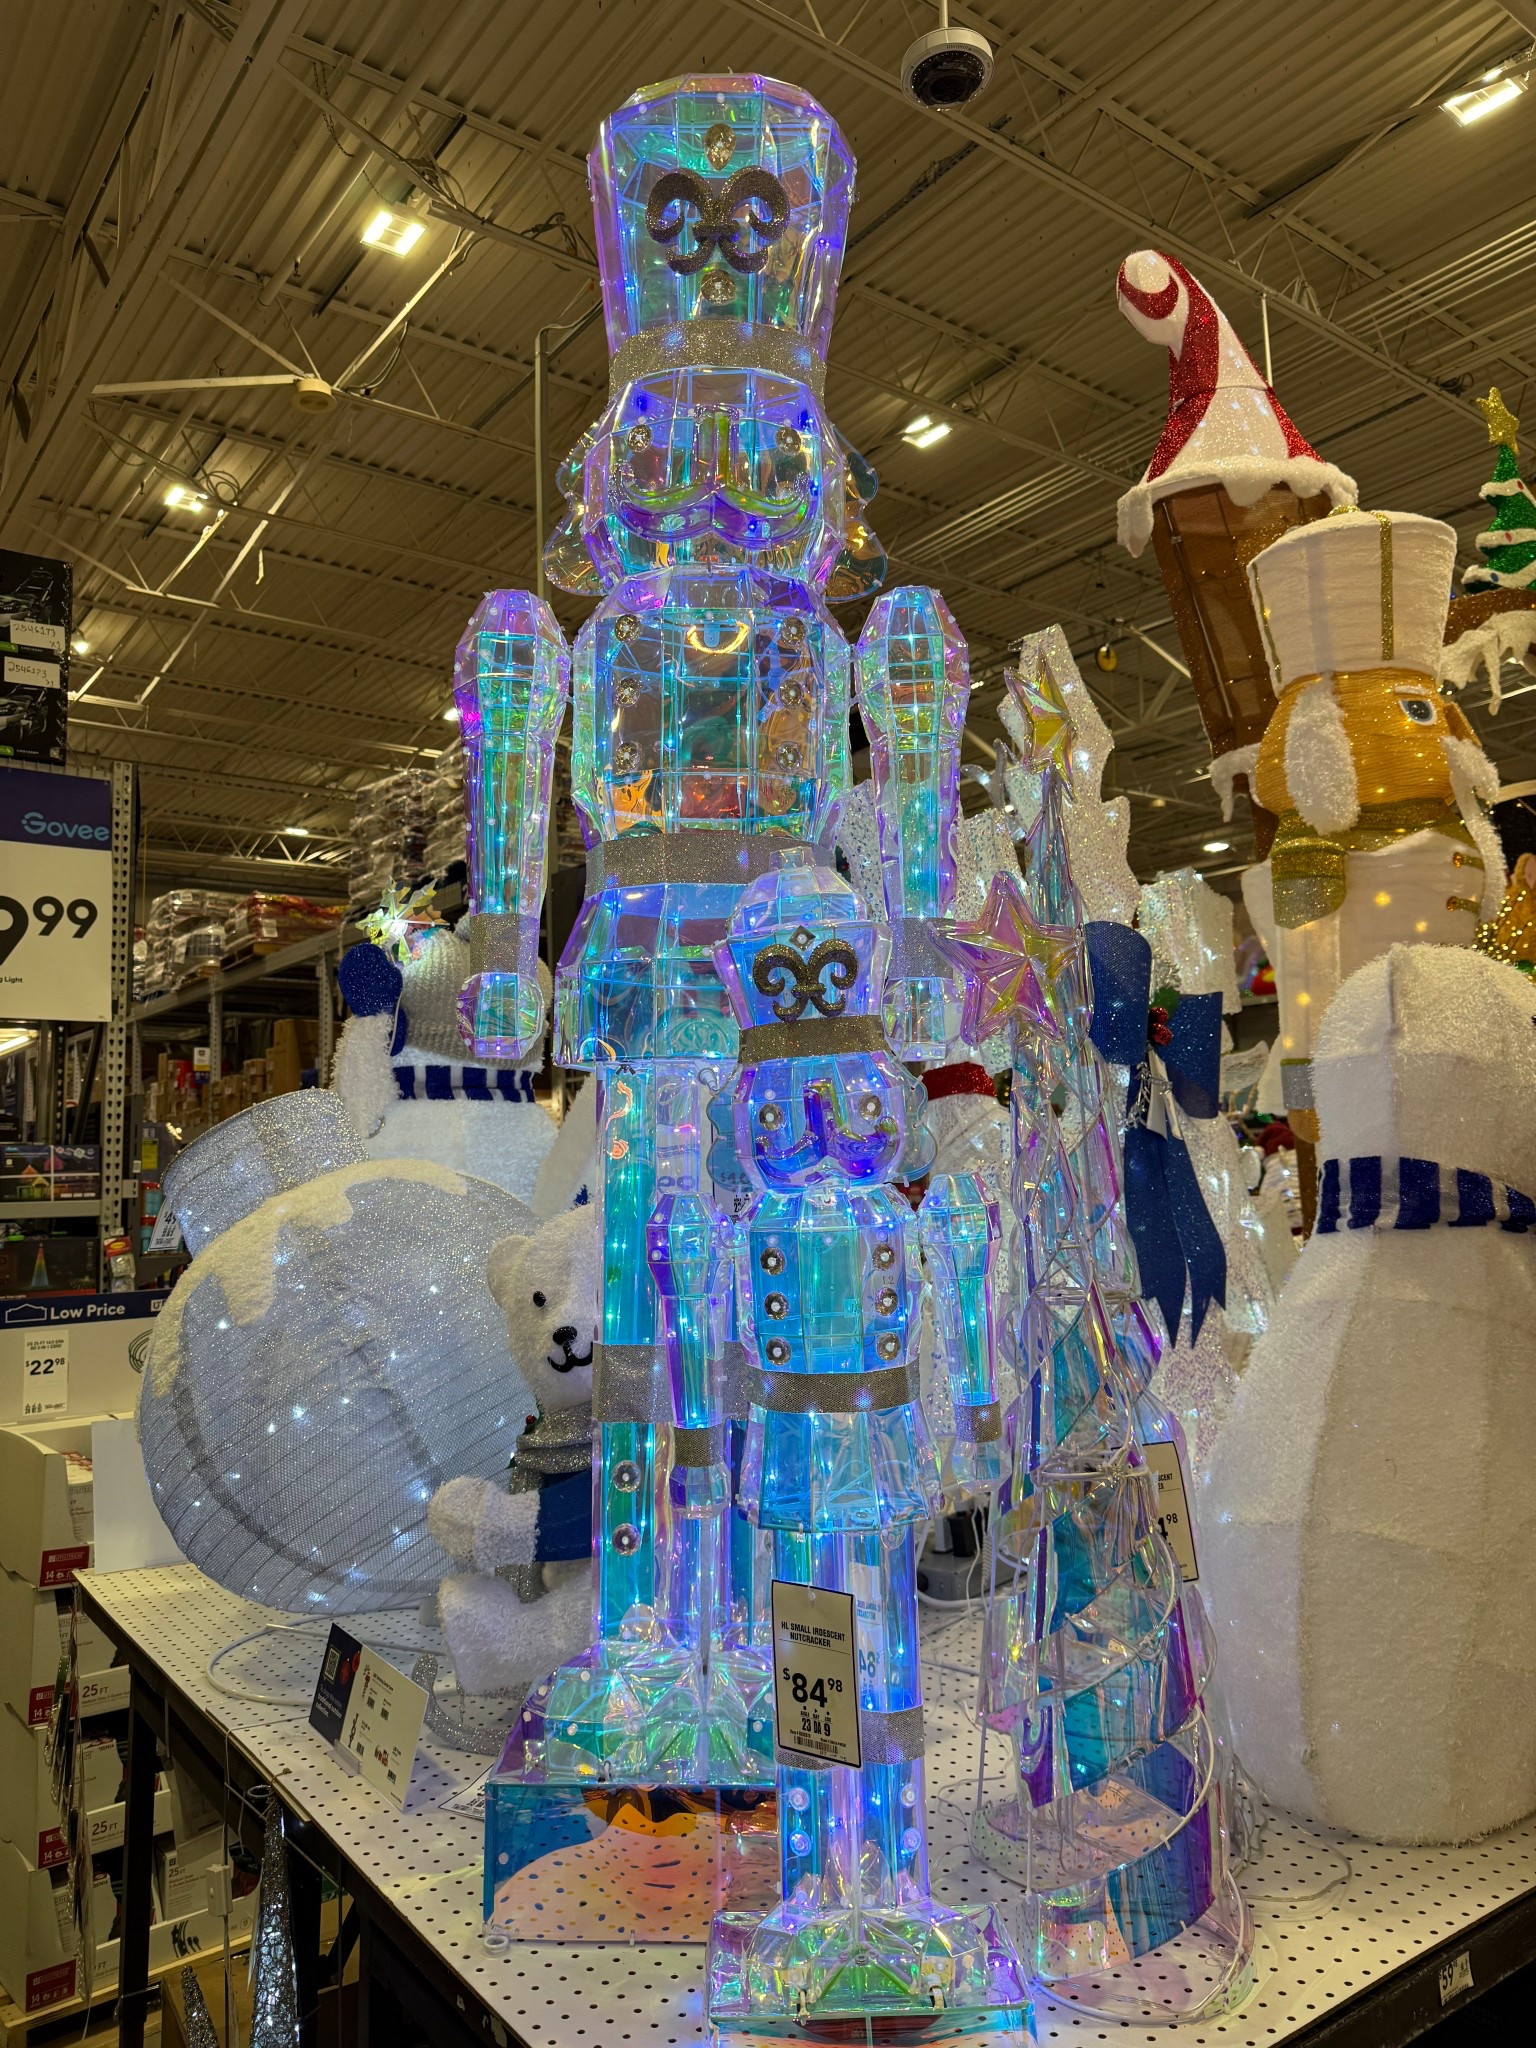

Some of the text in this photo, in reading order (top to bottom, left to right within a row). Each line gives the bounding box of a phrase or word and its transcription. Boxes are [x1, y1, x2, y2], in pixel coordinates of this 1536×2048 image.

[21, 812, 109, 841] Govee
[50, 1303, 125, 1320] Low Price
[781, 1621, 789, 1629] HL
[790, 1623, 811, 1634] SMALL
[790, 1632, 831, 1647] NUTCRACKER
[82, 1684, 98, 1698] 25
[33, 1708, 42, 1717] 14
[801, 1718, 811, 1732] 23
[824, 1723, 830, 1736] 9
[92, 1820, 108, 1835] 25
[109, 1822, 117, 1831] FT
[44, 1851, 53, 1860] 14
[168, 1868, 179, 1878] 25
